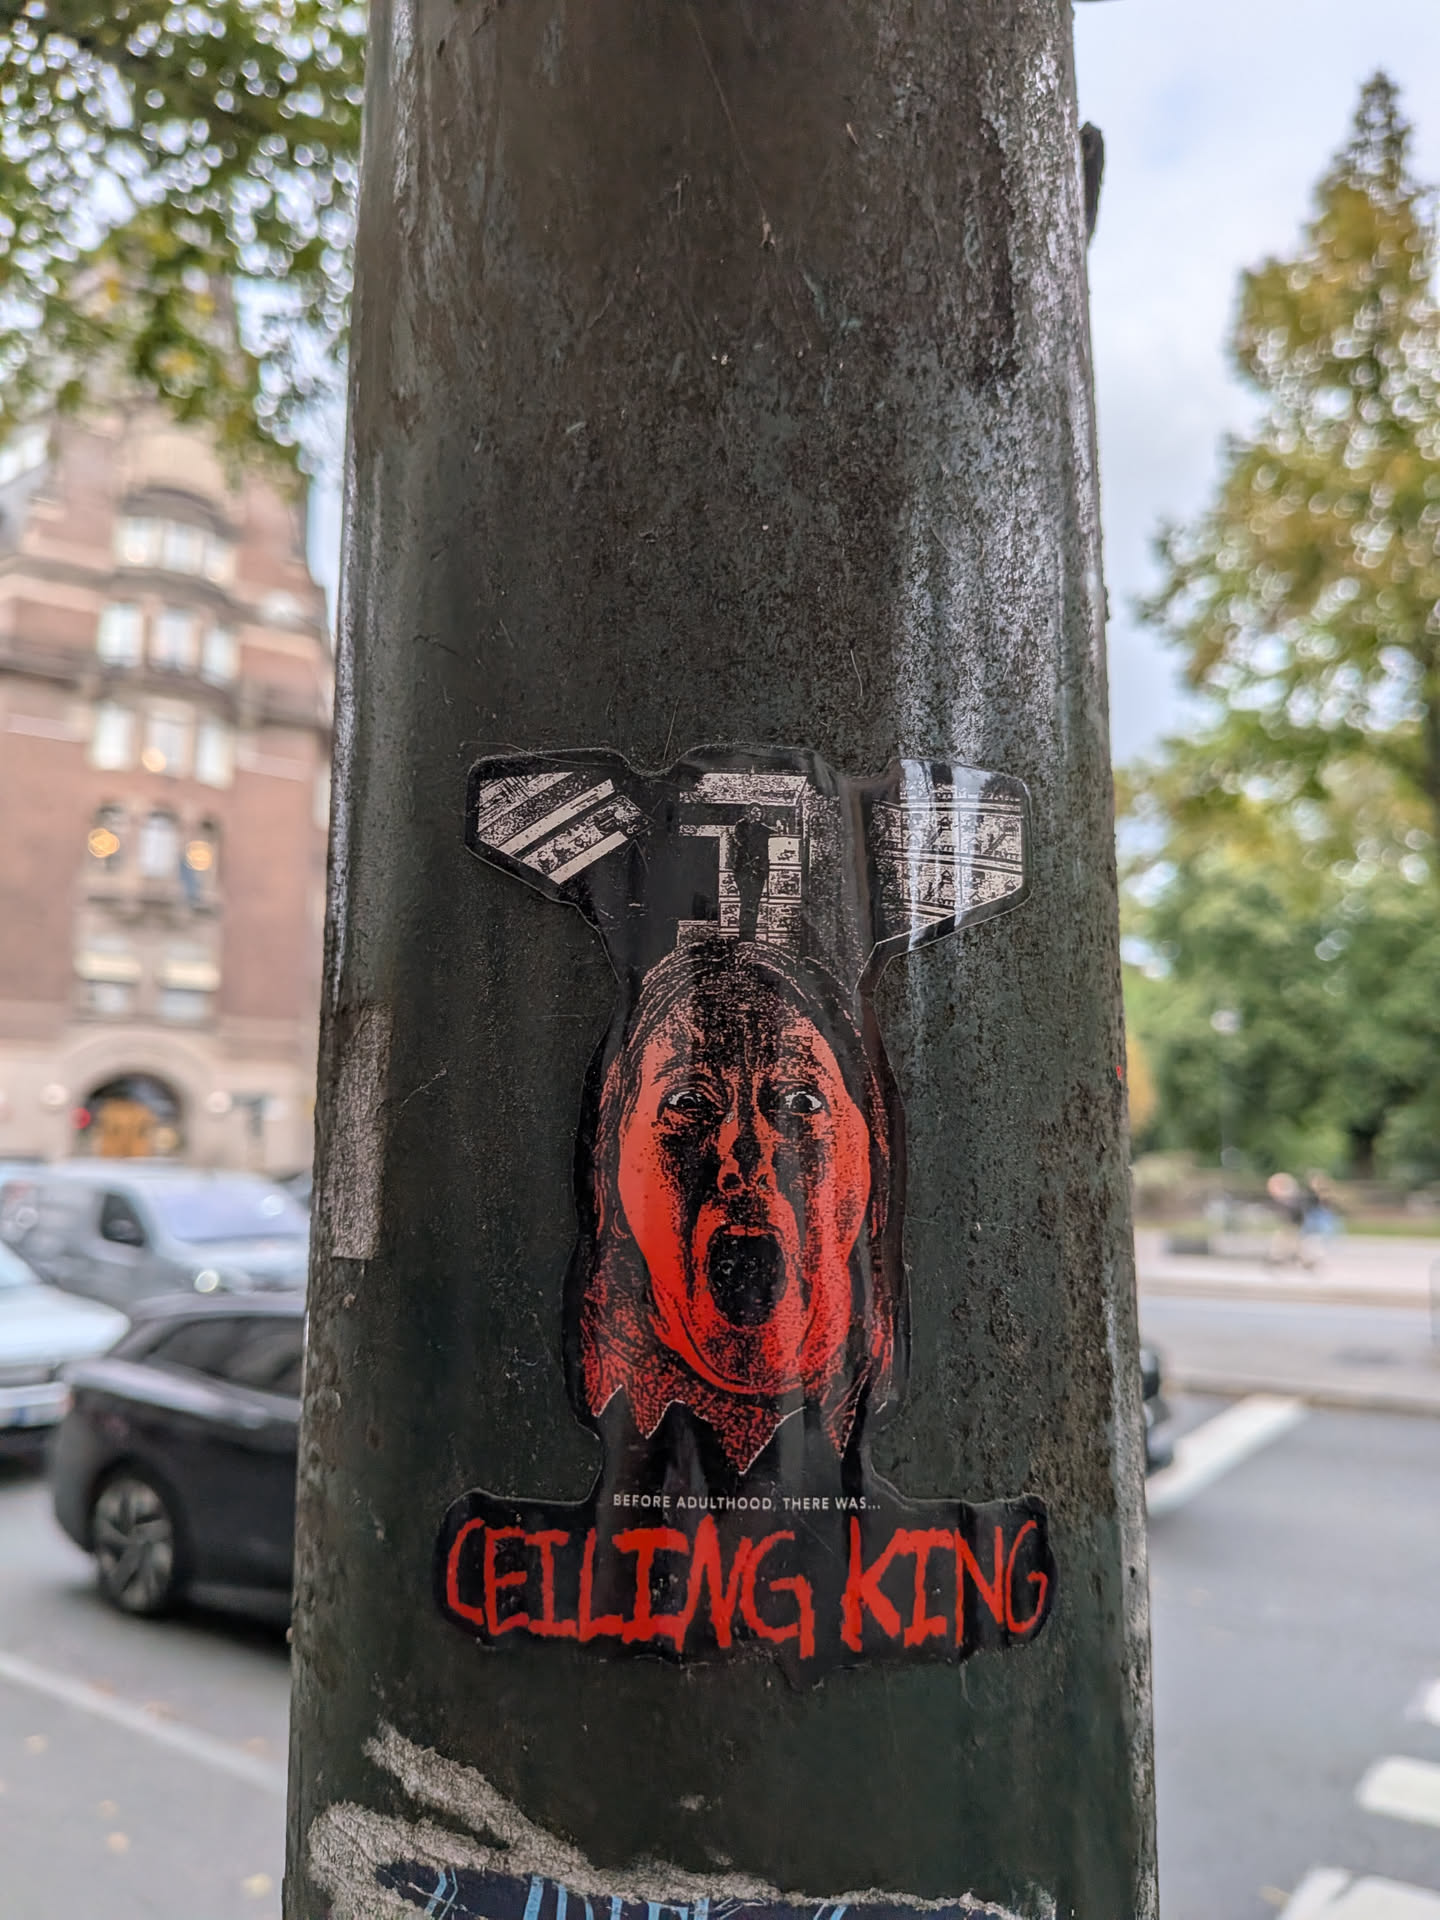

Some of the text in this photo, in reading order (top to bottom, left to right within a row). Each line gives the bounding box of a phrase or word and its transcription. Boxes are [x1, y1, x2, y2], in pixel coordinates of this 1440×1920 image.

[613, 1494, 881, 1511] BEFORE ADULTHOOD, THERE WAS...
[446, 1514, 1049, 1659] CEILING KING
